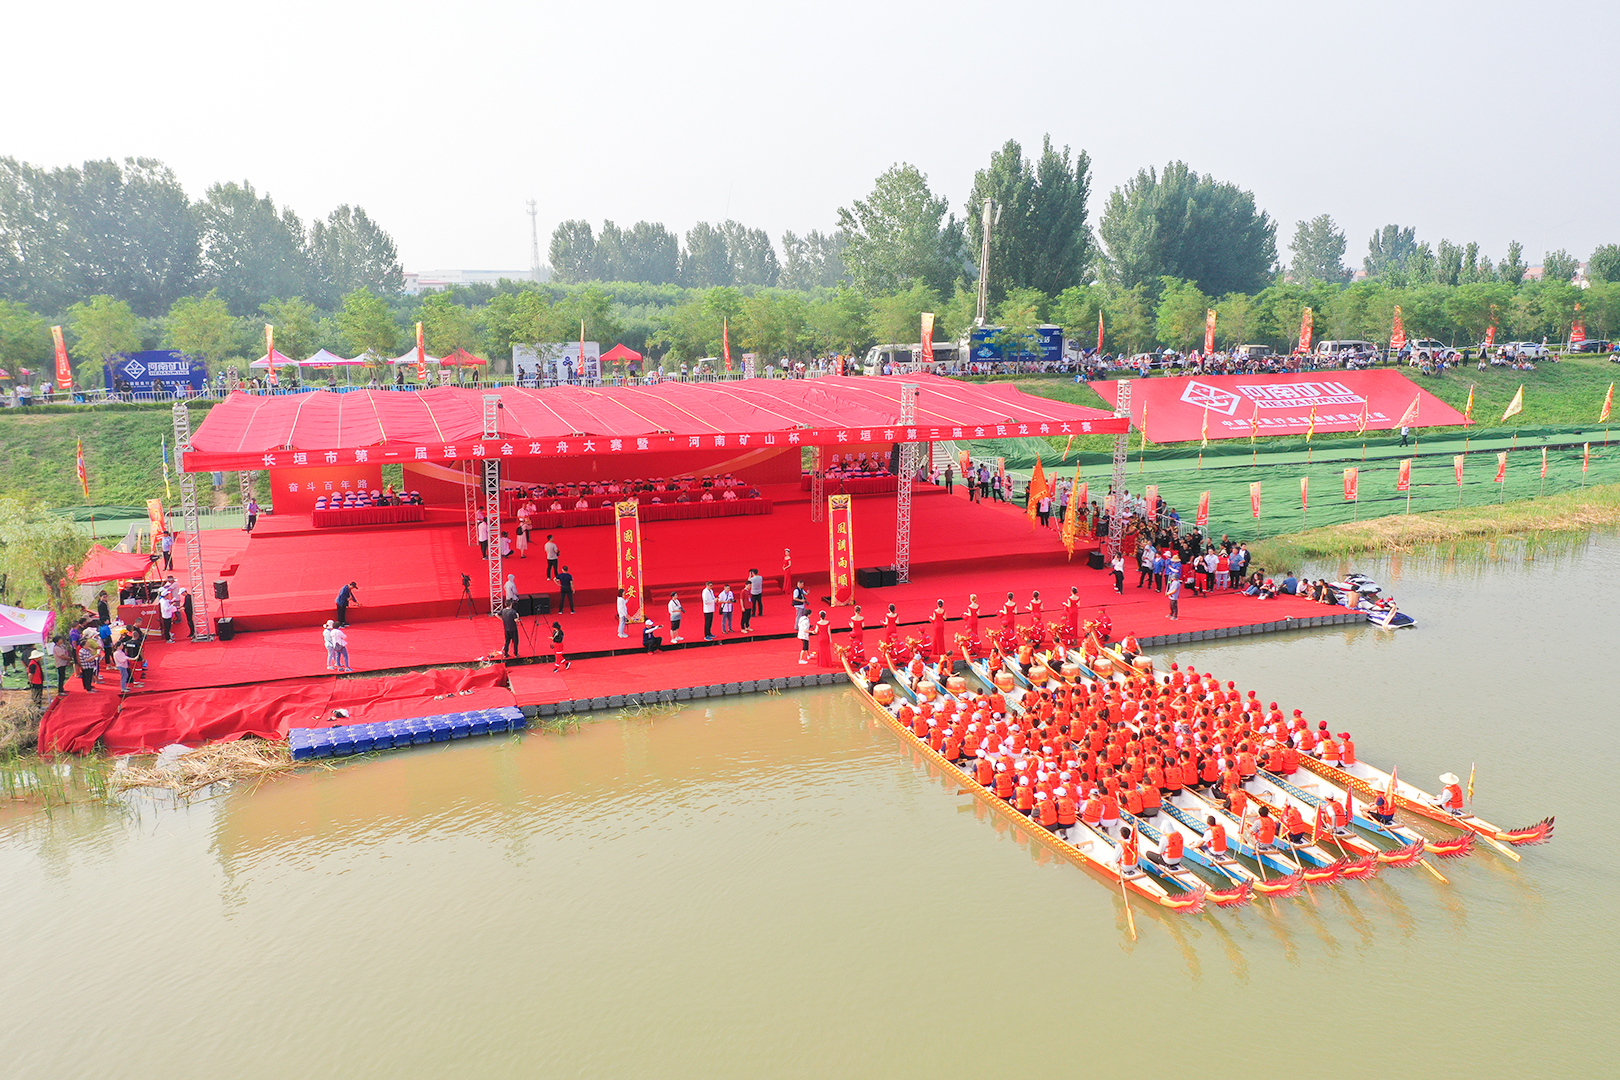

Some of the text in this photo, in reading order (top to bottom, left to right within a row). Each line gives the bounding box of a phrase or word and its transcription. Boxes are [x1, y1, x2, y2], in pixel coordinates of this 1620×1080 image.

[1235, 381, 1355, 400] 河南矿山
[288, 479, 368, 492] 奋斗百年路
